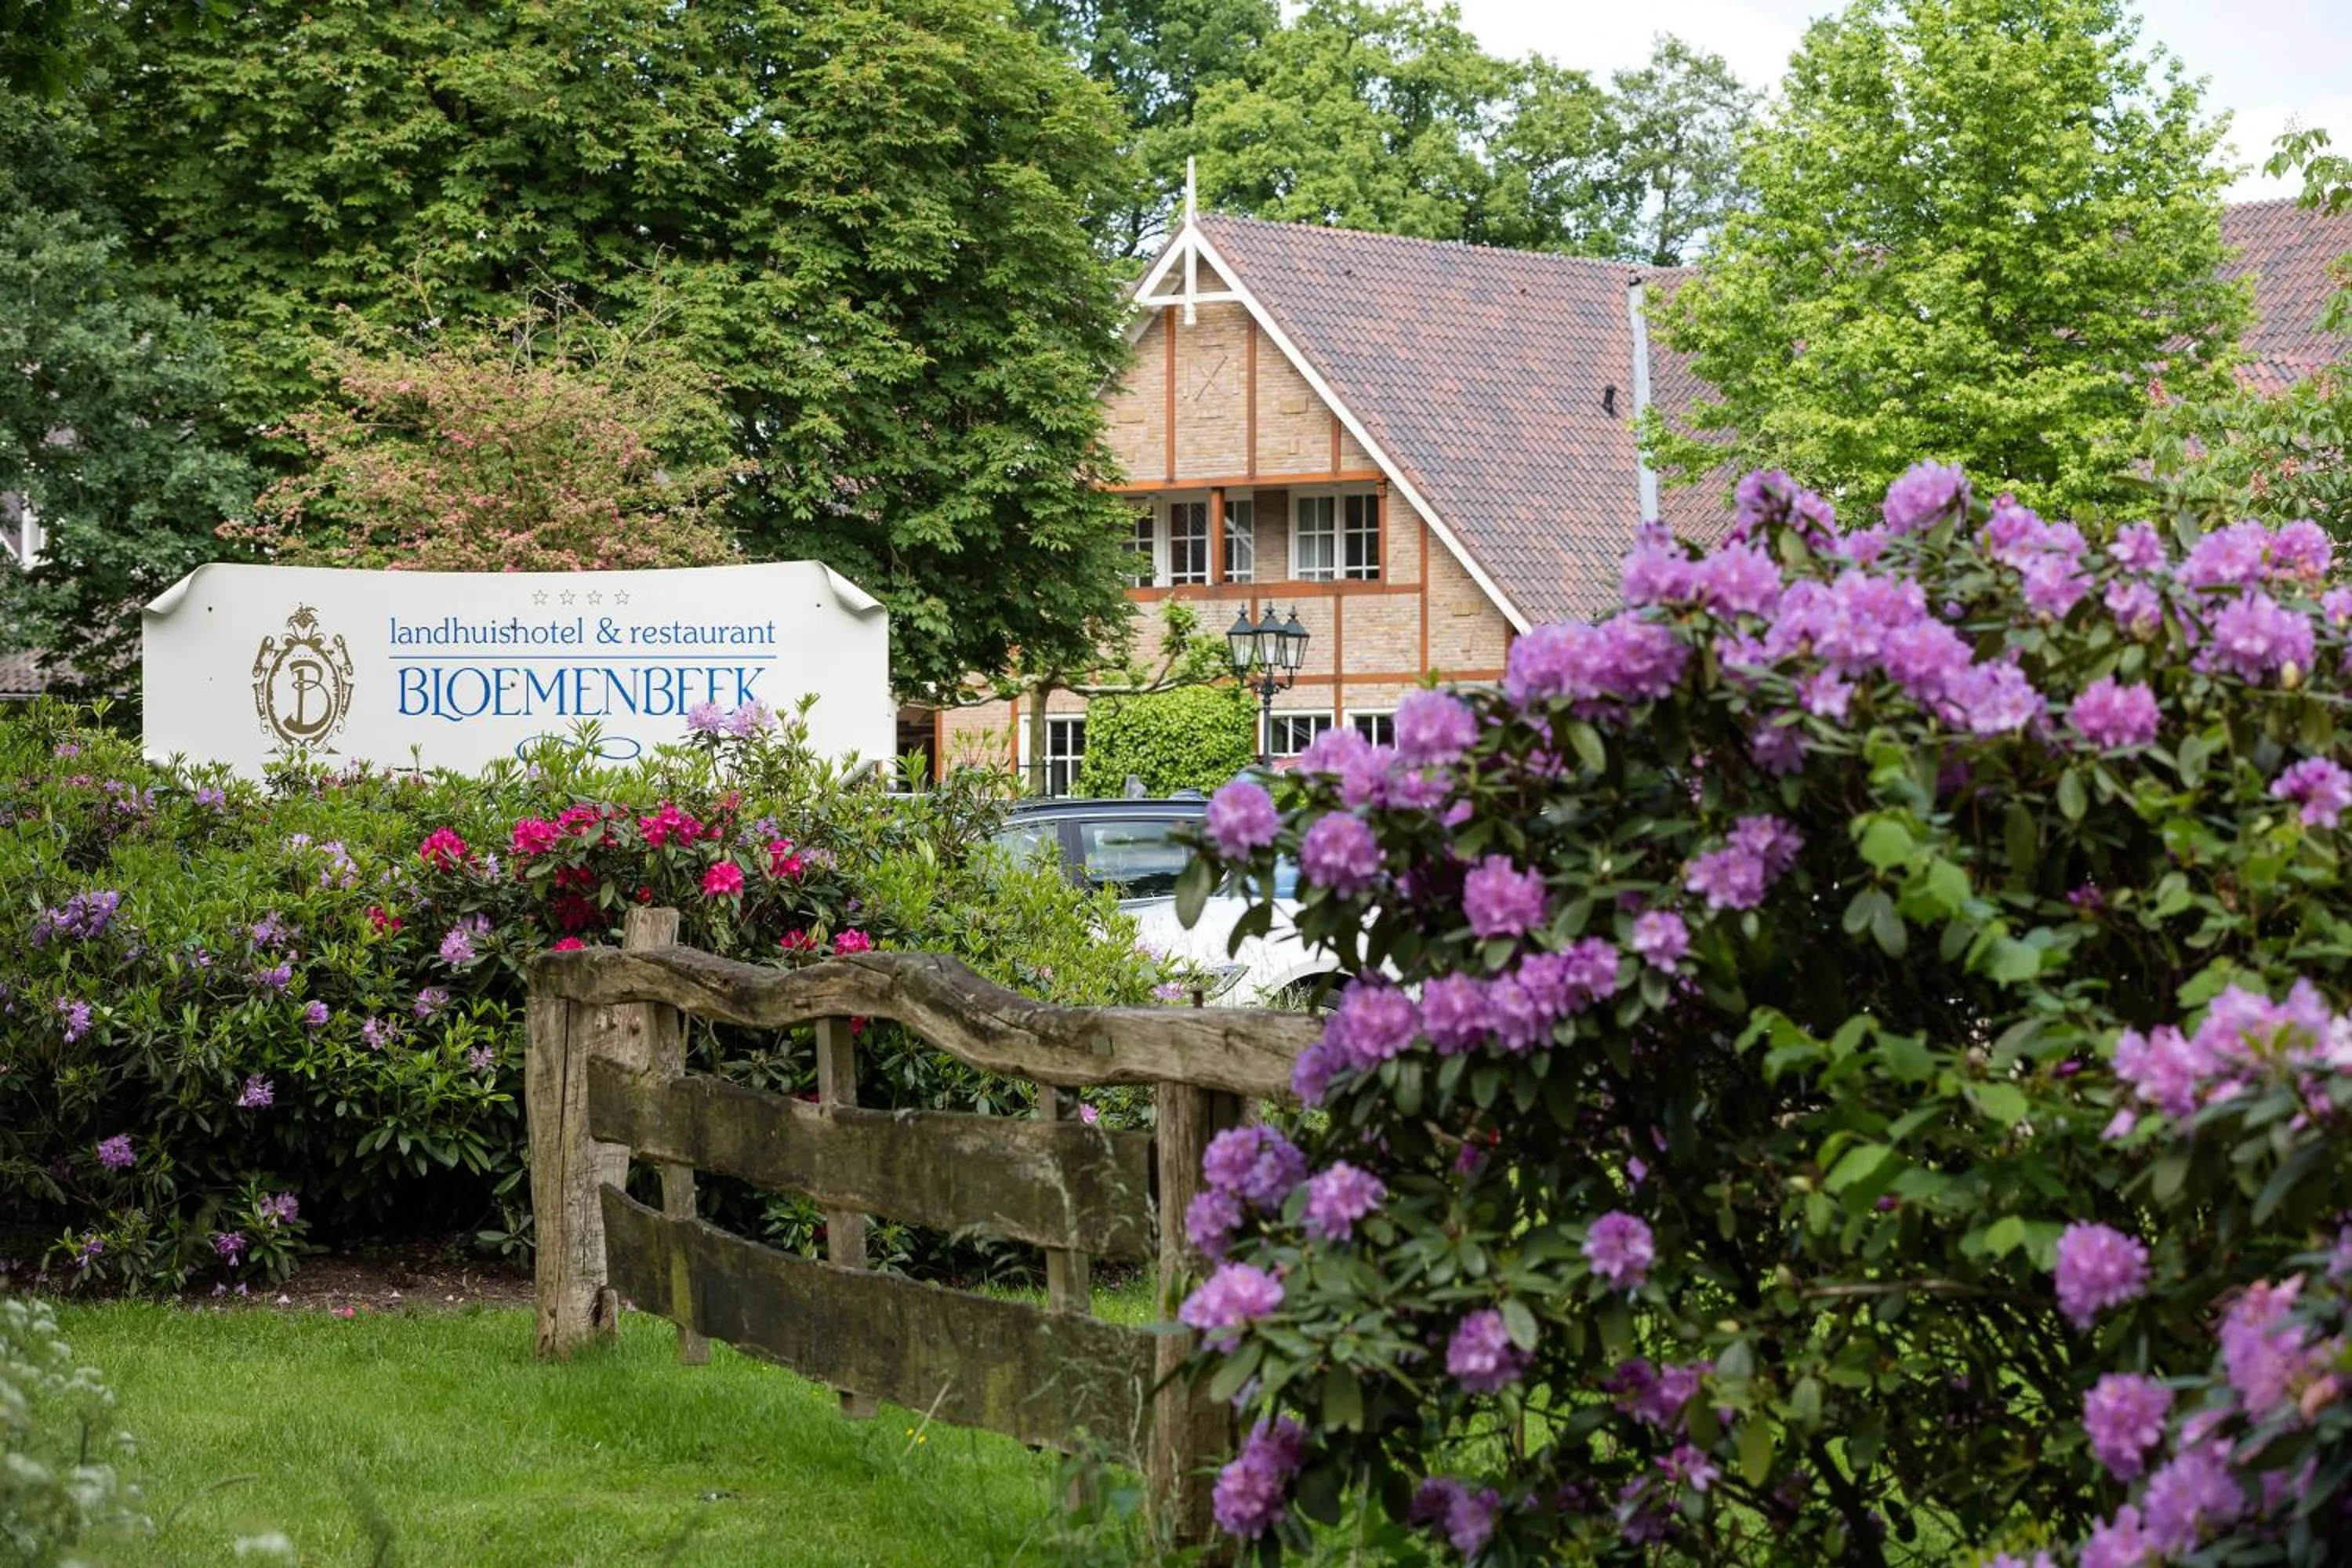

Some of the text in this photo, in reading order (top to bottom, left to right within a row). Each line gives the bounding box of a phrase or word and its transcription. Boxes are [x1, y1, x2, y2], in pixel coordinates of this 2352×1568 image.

[390, 617, 775, 644] landhuishotel & restaurant
[398, 666, 766, 721] BLOEMENBEEK
